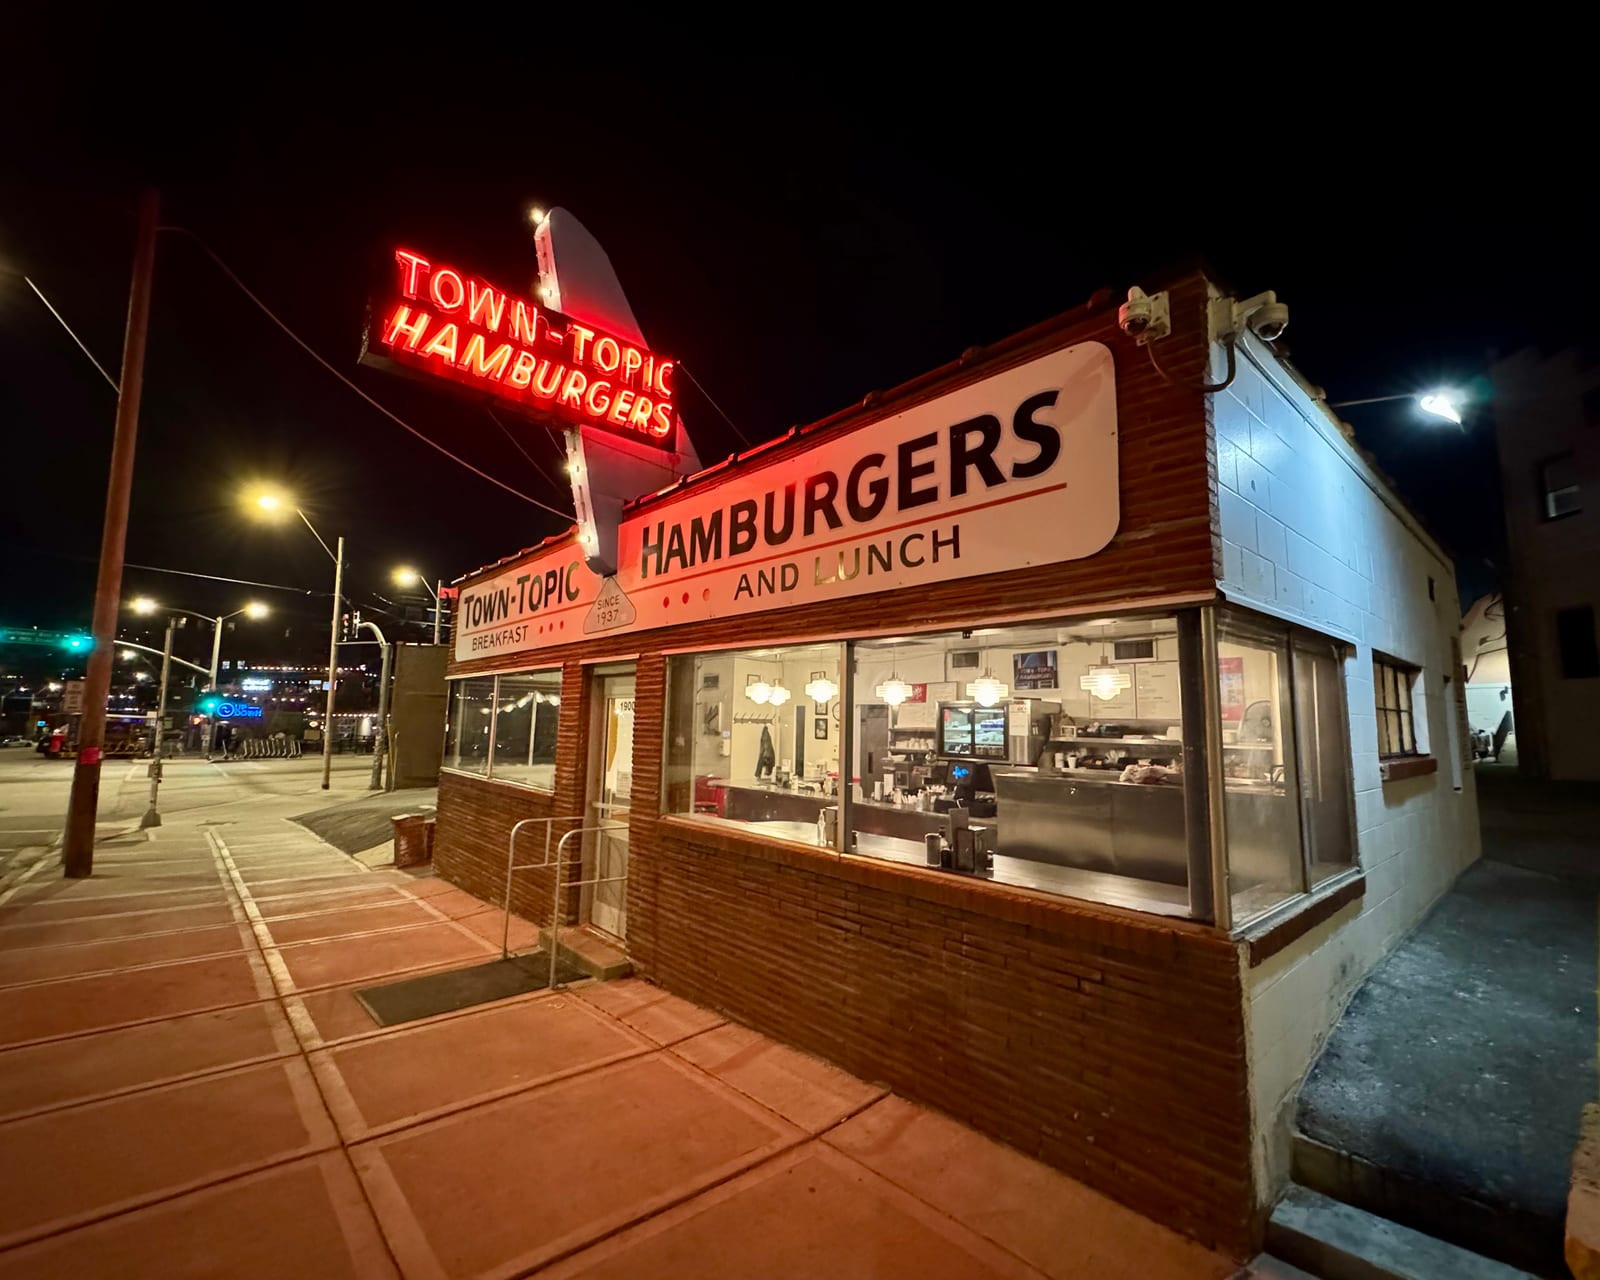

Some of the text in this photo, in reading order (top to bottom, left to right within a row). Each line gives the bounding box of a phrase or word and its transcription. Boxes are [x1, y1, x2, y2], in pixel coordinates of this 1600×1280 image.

[382, 305, 673, 438] HAMBURGERS
[641, 388, 1062, 579] HAMBURGERS
[463, 560, 581, 630] TOWN-TOPIC
[733, 523, 962, 601] AND LUNCH
[596, 594, 621, 611] SINCE
[596, 609, 620, 626] 1937
[472, 625, 529, 651] BREAKFAST
